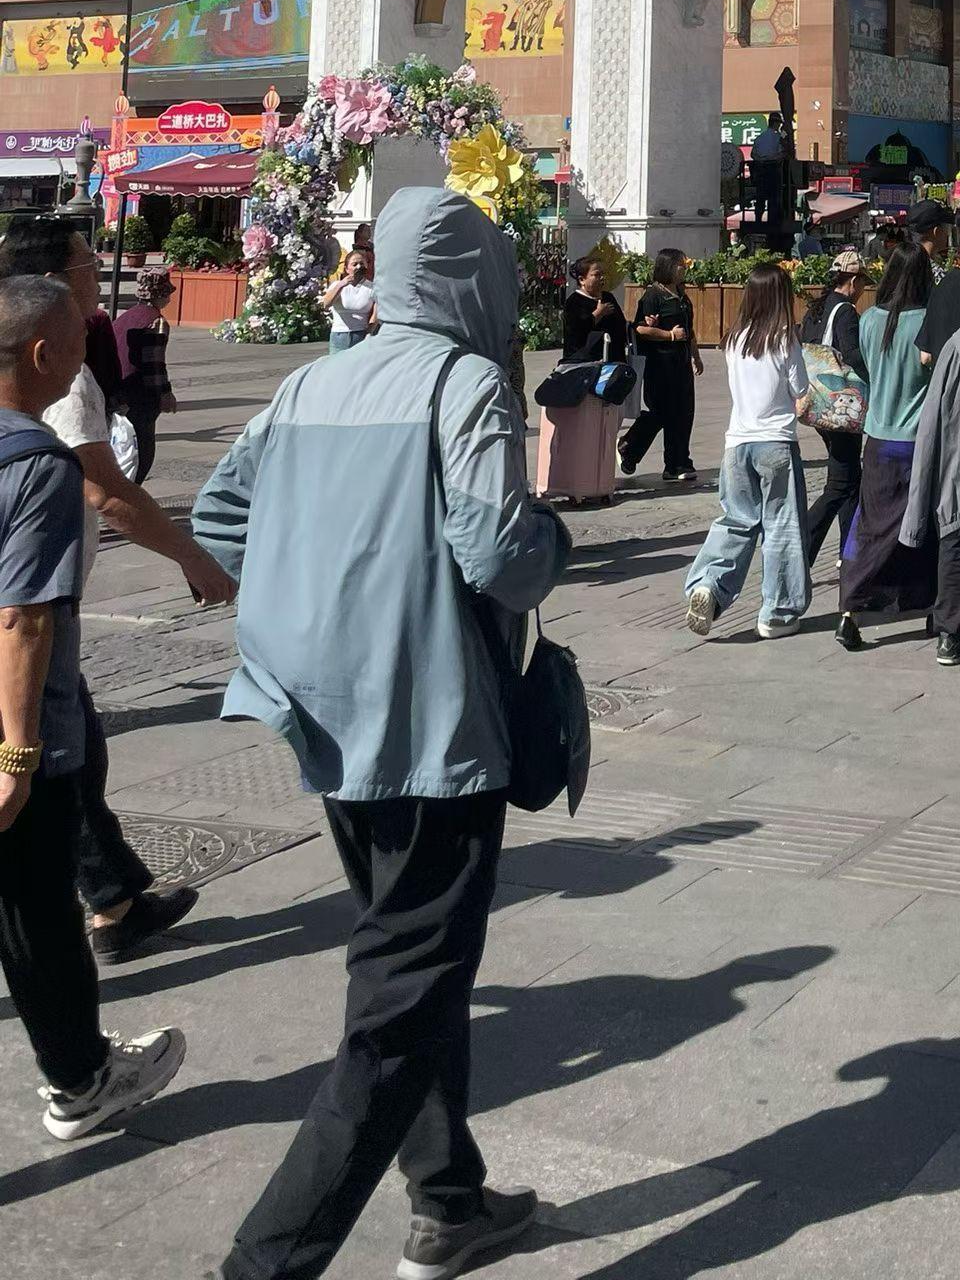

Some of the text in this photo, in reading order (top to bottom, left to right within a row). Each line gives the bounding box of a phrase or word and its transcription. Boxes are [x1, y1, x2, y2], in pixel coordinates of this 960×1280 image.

[160, 113, 227, 129] 二道桥大巴扎
